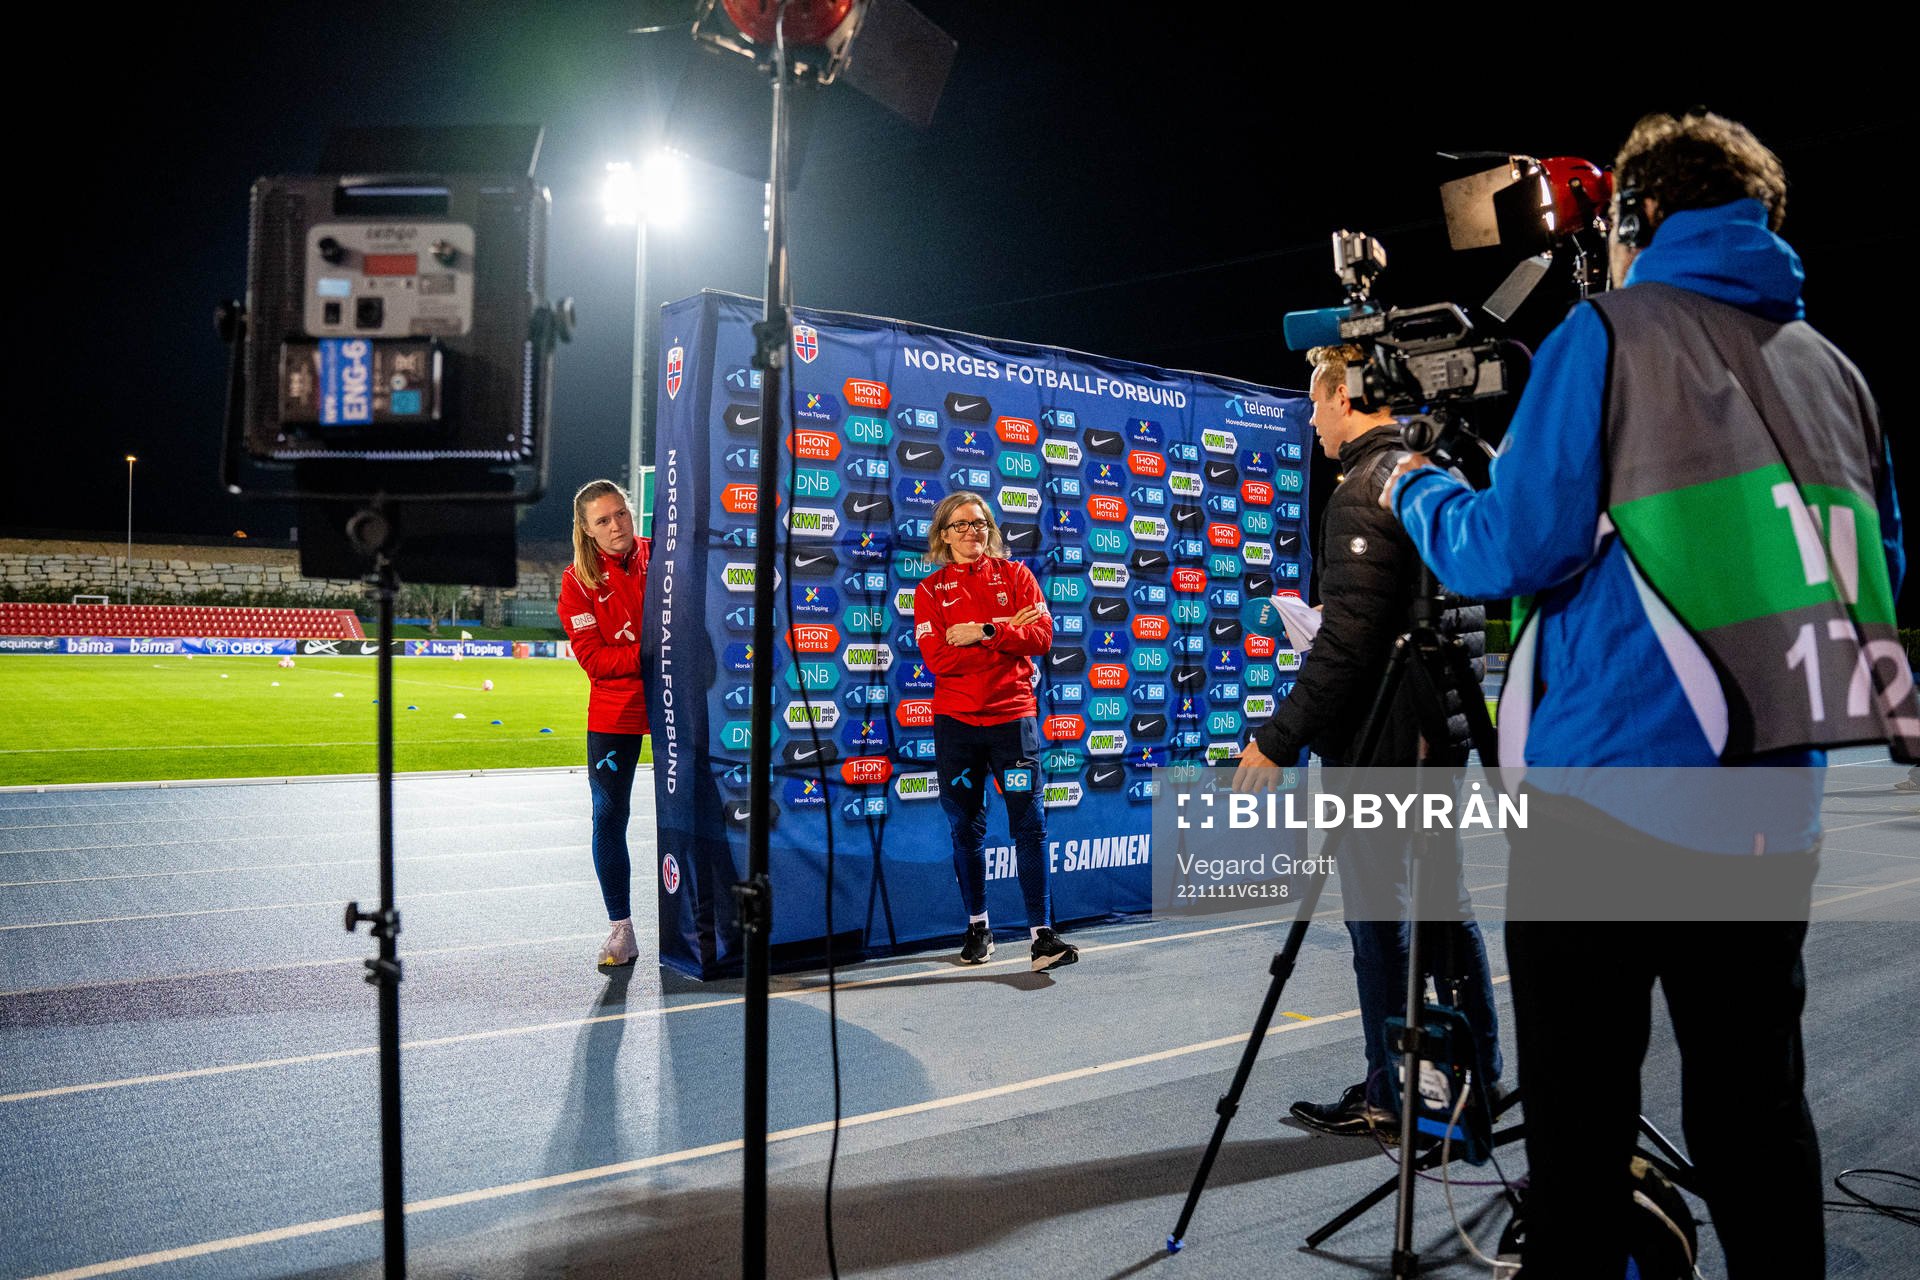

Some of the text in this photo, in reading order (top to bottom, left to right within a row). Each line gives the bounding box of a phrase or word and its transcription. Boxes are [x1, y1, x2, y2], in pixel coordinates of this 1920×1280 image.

[342, 340, 368, 421] ENG-6
[904, 348, 1186, 408] NORGES FOTBALLFORBUND
[850, 383, 884, 396] THON
[855, 397, 881, 405] HOTELS
[1244, 401, 1284, 418] telenor
[918, 414, 934, 424] 5G
[1059, 415, 1073, 424] 5G
[855, 419, 883, 442] DNB
[1001, 420, 1032, 433] THON
[795, 433, 834, 447] THON
[1006, 433, 1029, 441] HOTELS
[800, 448, 829, 456] HOTELS
[1046, 444, 1068, 459] KIWI
[1184, 448, 1196, 457] 5G
[1006, 454, 1032, 475] DNB
[1133, 454, 1160, 466] THON
[869, 464, 886, 474] 5G
[797, 472, 829, 494] DNB
[972, 474, 987, 484] 5G
[1172, 476, 1191, 490] KIWI
[1281, 472, 1298, 490] DNB
[1064, 482, 1077, 492] 5G
[1246, 484, 1269, 494] THON
[730, 488, 758, 500] THO
[1002, 492, 1027, 507] KIWI
[1149, 492, 1161, 500] 5G
[1093, 498, 1121, 511] THON
[1222, 500, 1234, 508] 5G
[791, 513, 820, 529] KIWI
[1134, 520, 1155, 535] KIWI
[1248, 513, 1267, 532] DNB
[1212, 526, 1236, 537] THON
[1097, 530, 1120, 551] DNB
[1188, 544, 1200, 552] 5G
[1066, 551, 1080, 560] 5G
[905, 555, 931, 576] DNB
[1216, 557, 1235, 576] DNB
[1093, 567, 1115, 581] KIWI
[1177, 571, 1202, 581] THON
[868, 577, 884, 587] 5G
[1054, 579, 1078, 600] DNB
[1151, 589, 1163, 598] 5G
[1179, 602, 1200, 622] DNB
[661, 450, 678, 794] NORGES FOTBALLFORBUND
[854, 608, 882, 631] DNB
[1066, 619, 1080, 628] 5G
[1137, 618, 1164, 628] THON
[793, 627, 832, 640] THON
[1, 640, 42, 650] equinor
[1189, 640, 1201, 648] 5G
[1249, 636, 1271, 646] THON
[231, 642, 273, 654] OBOS
[464, 643, 504, 656] Tipping
[848, 649, 876, 664] KIWI
[1140, 650, 1161, 670] DNB
[798, 665, 828, 688] DNB
[1094, 666, 1123, 677] THON
[1251, 666, 1269, 686] DNB
[868, 690, 885, 699] 5G
[1064, 688, 1078, 697] 5G
[1150, 688, 1162, 696] 5G
[1225, 687, 1236, 695] 5G
[903, 702, 931, 714] THON
[1097, 699, 1119, 719] DNB
[1049, 717, 1079, 728] THON
[1214, 713, 1234, 732] DNB
[1091, 735, 1113, 749] KIWI
[1185, 735, 1198, 743] 5G
[920, 743, 935, 753] 5G
[849, 760, 885, 772] THON
[1051, 750, 1075, 771] DNB
[901, 778, 927, 793] KIWI
[1006, 773, 1028, 787] 5G
[1044, 787, 1068, 801] KIWI
[868, 801, 884, 811] 5G
[1064, 834, 1150, 872] SAMMEN
